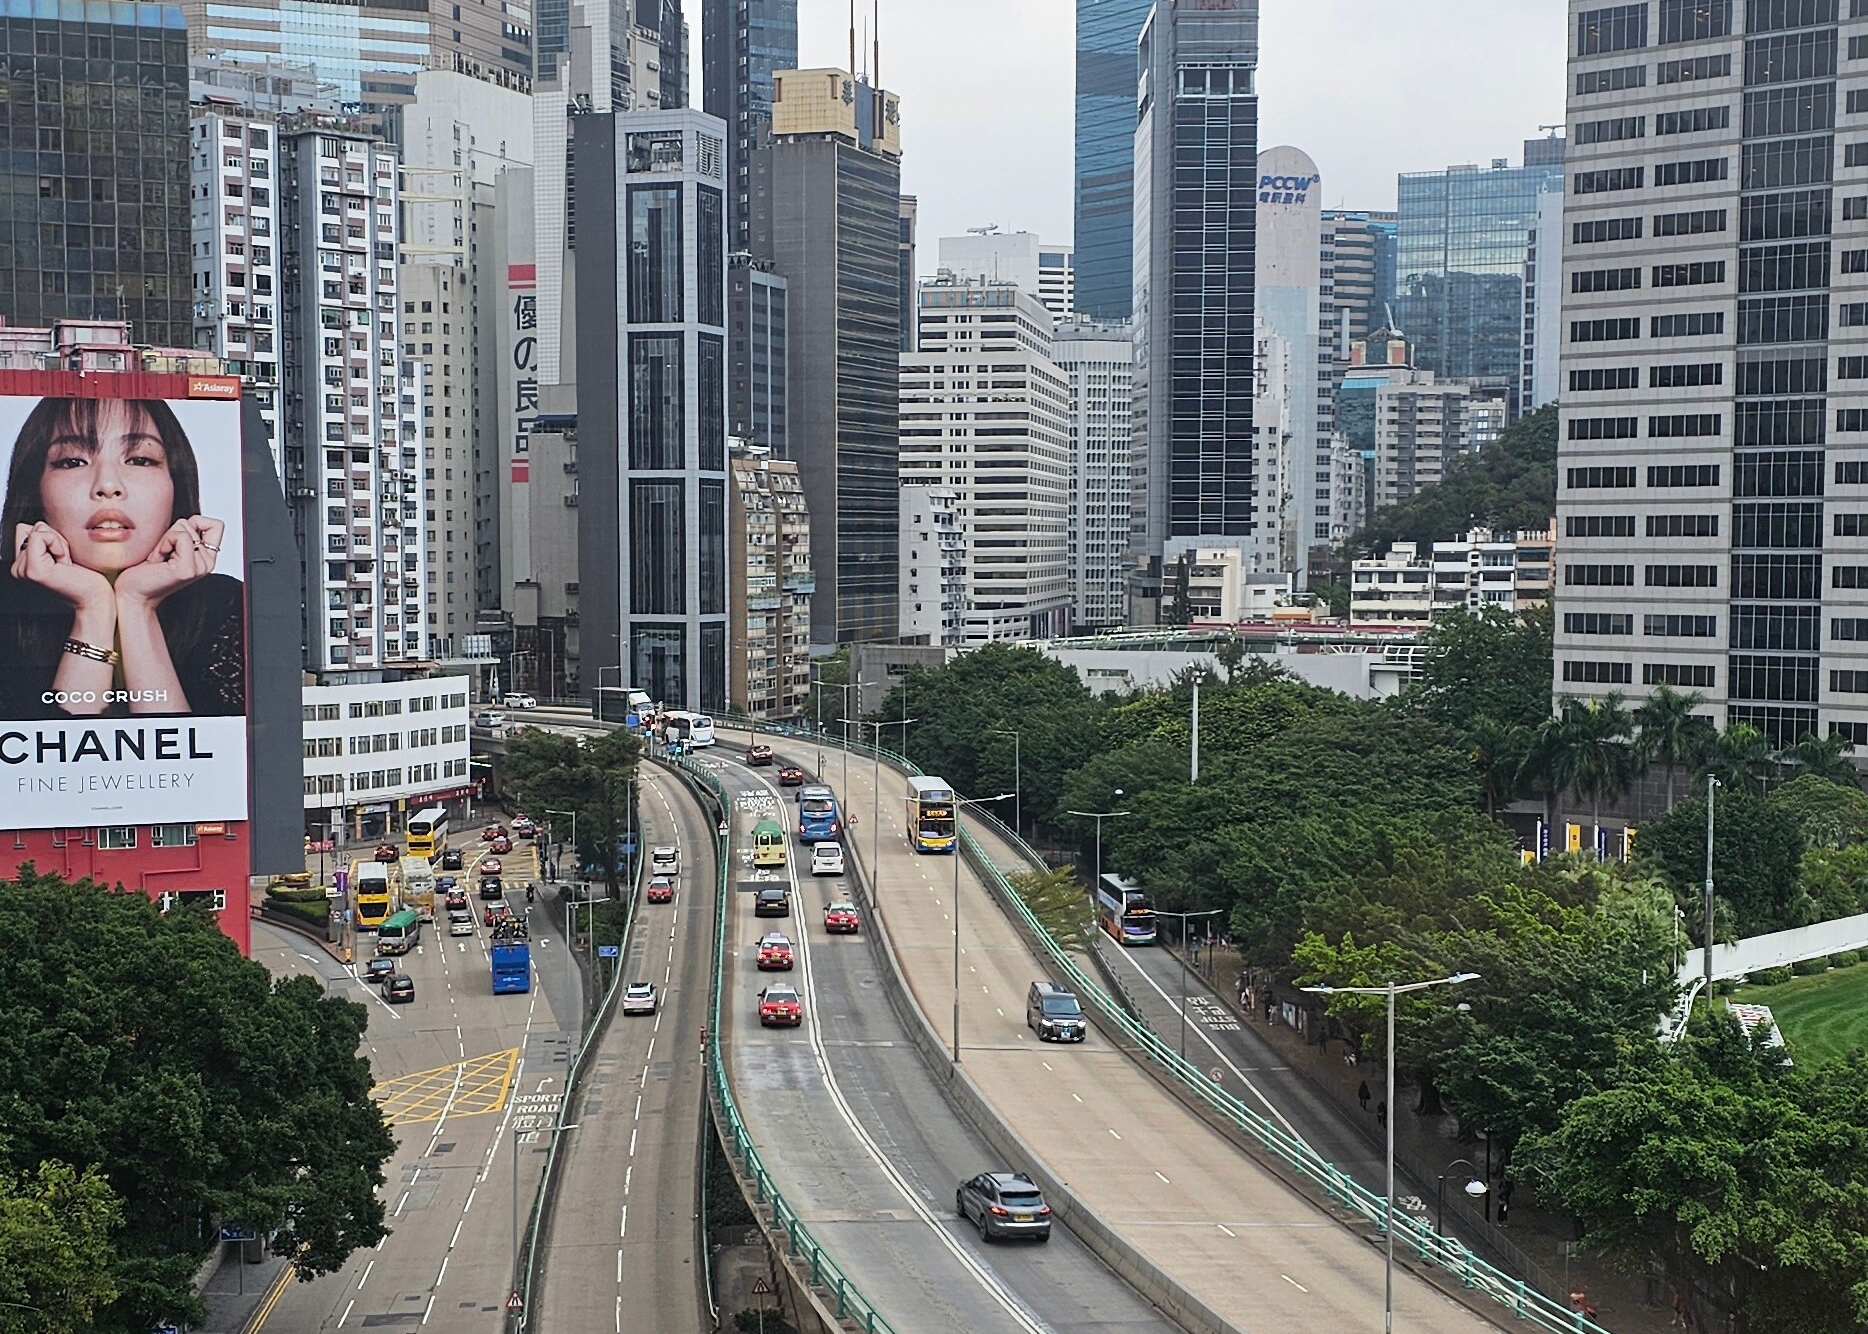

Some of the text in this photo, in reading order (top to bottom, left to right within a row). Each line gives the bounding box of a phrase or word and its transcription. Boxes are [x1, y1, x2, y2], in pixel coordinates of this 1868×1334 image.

[1259, 175, 1312, 191] PCCW
[41, 689, 168, 704] COCO CRUSH
[0, 728, 213, 765] CHANEL
[18, 772, 195, 794] FINE JEWELLERY
[517, 1104, 558, 1113] ROAD
